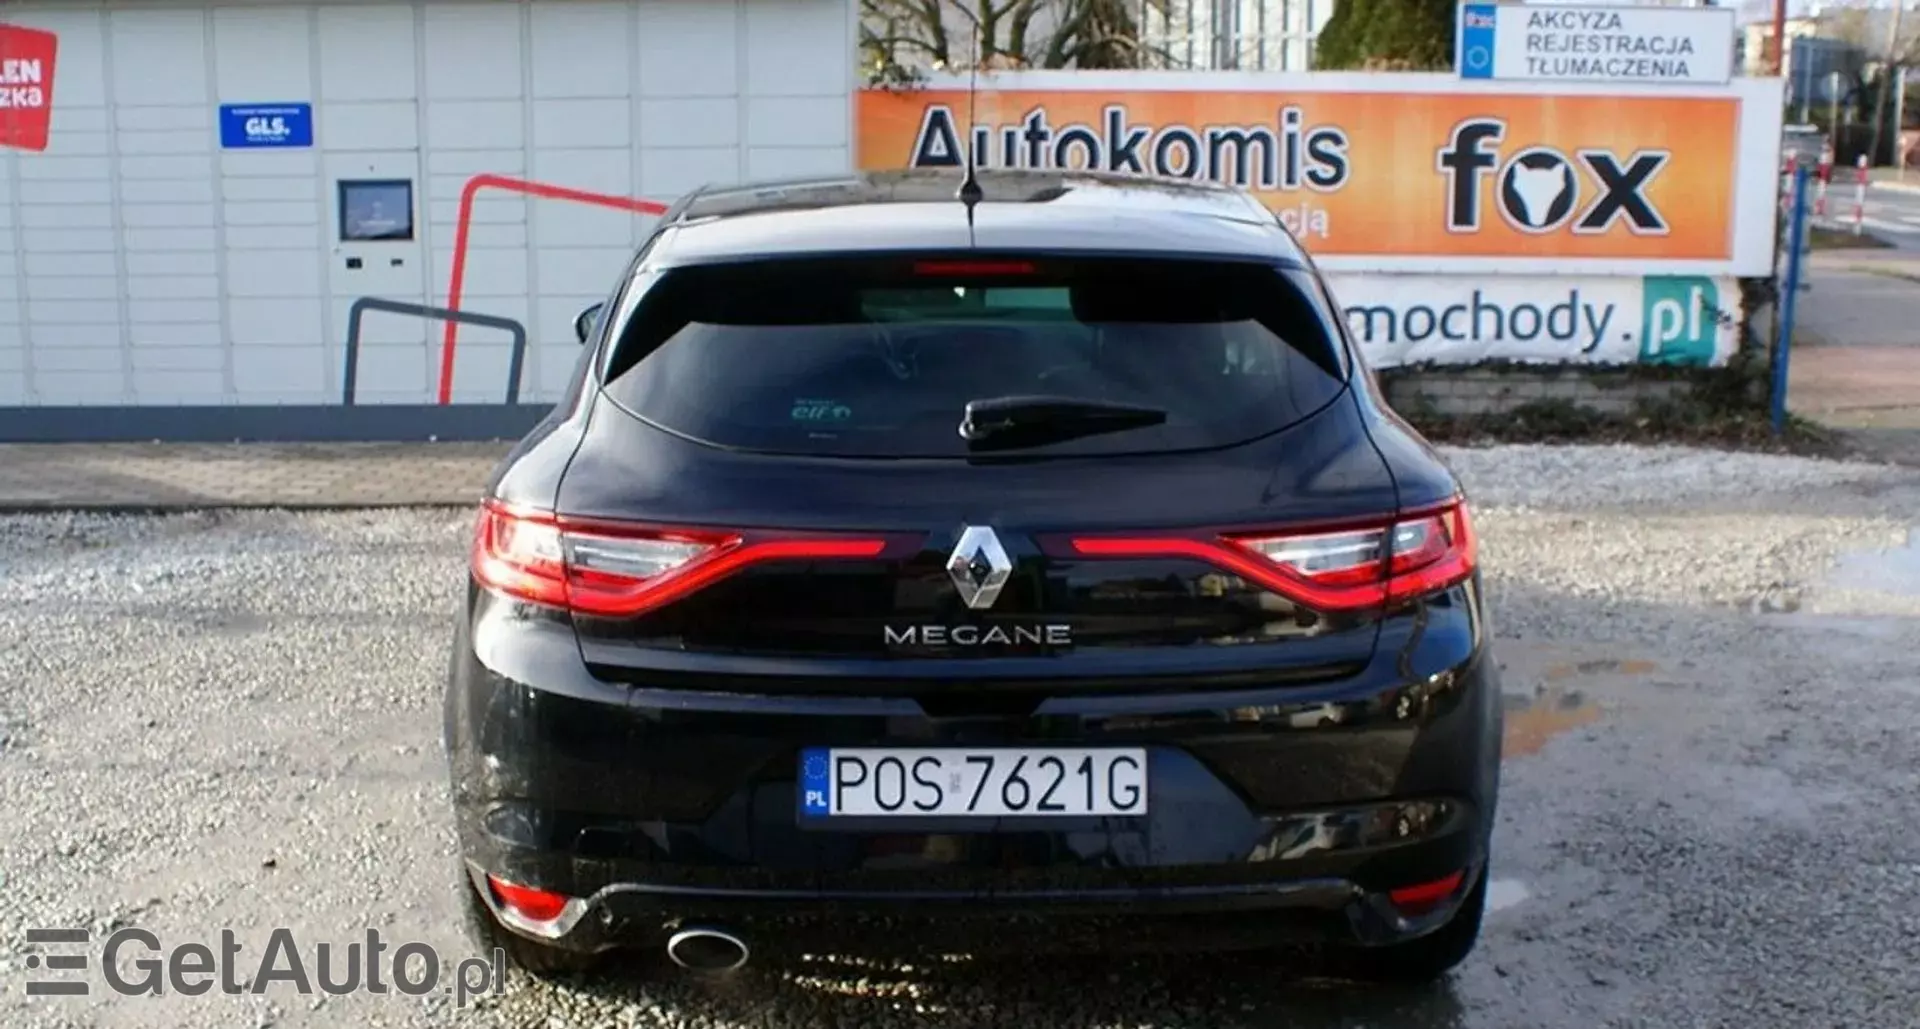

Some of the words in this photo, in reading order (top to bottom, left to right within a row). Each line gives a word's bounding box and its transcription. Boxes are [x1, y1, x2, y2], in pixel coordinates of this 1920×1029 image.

[1527, 11, 1622, 29] AKCYZA
[1526, 33, 1694, 54] REJESTRACJA
[1526, 57, 1690, 77] TŁUMACZENIA
[913, 104, 1350, 190] Autokomis
[1438, 117, 1671, 236] fox
[884, 624, 1072, 645] MEGANE
[835, 755, 944, 812] POS
[965, 755, 1140, 812] 7621G
[805, 790, 827, 806] PL
